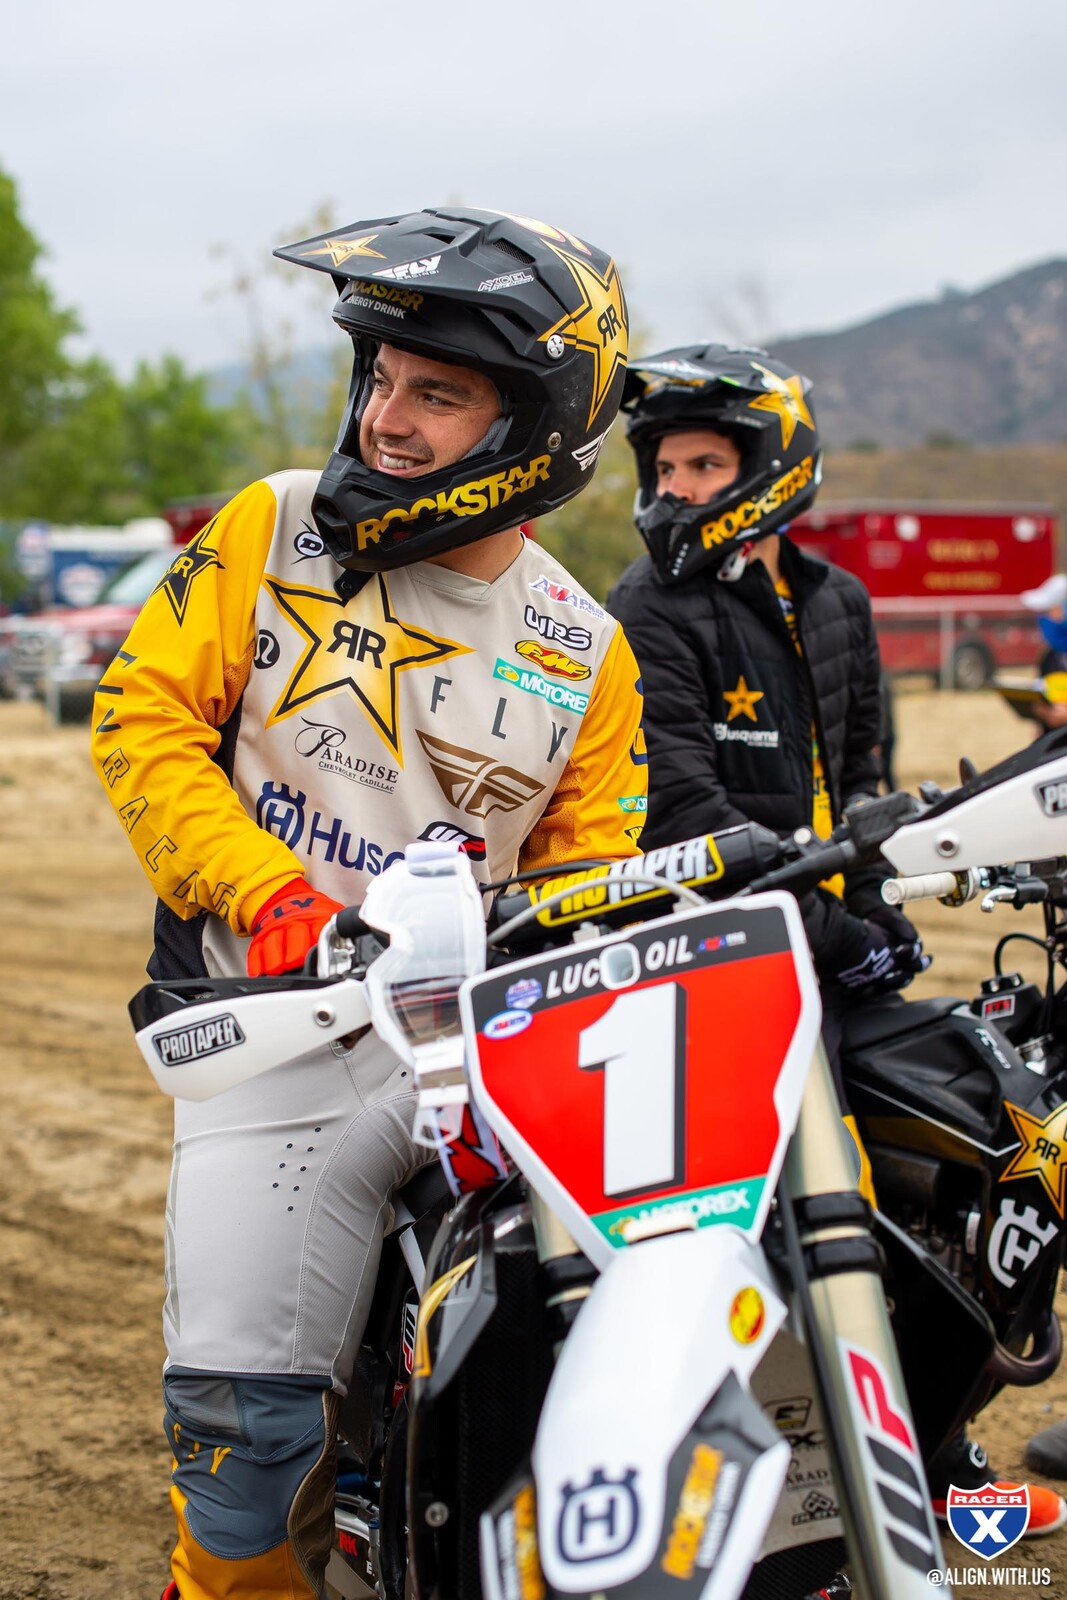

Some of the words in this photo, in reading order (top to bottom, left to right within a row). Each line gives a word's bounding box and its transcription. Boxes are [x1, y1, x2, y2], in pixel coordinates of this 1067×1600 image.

[374, 301, 407, 319] DRINK
[356, 454, 551, 551] ROCKSTAR
[701, 456, 813, 549] ROCKSTAR
[532, 578, 578, 607] AMA
[520, 672, 588, 713] MOTORE
[294, 715, 399, 784] PARADISE
[318, 761, 357, 780] CHEVROLET
[359, 775, 395, 793] CADILLAC
[644, 935, 693, 971] OIL
[160, 1015, 238, 1061] PROTAPER
[577, 980, 688, 1200] 1
